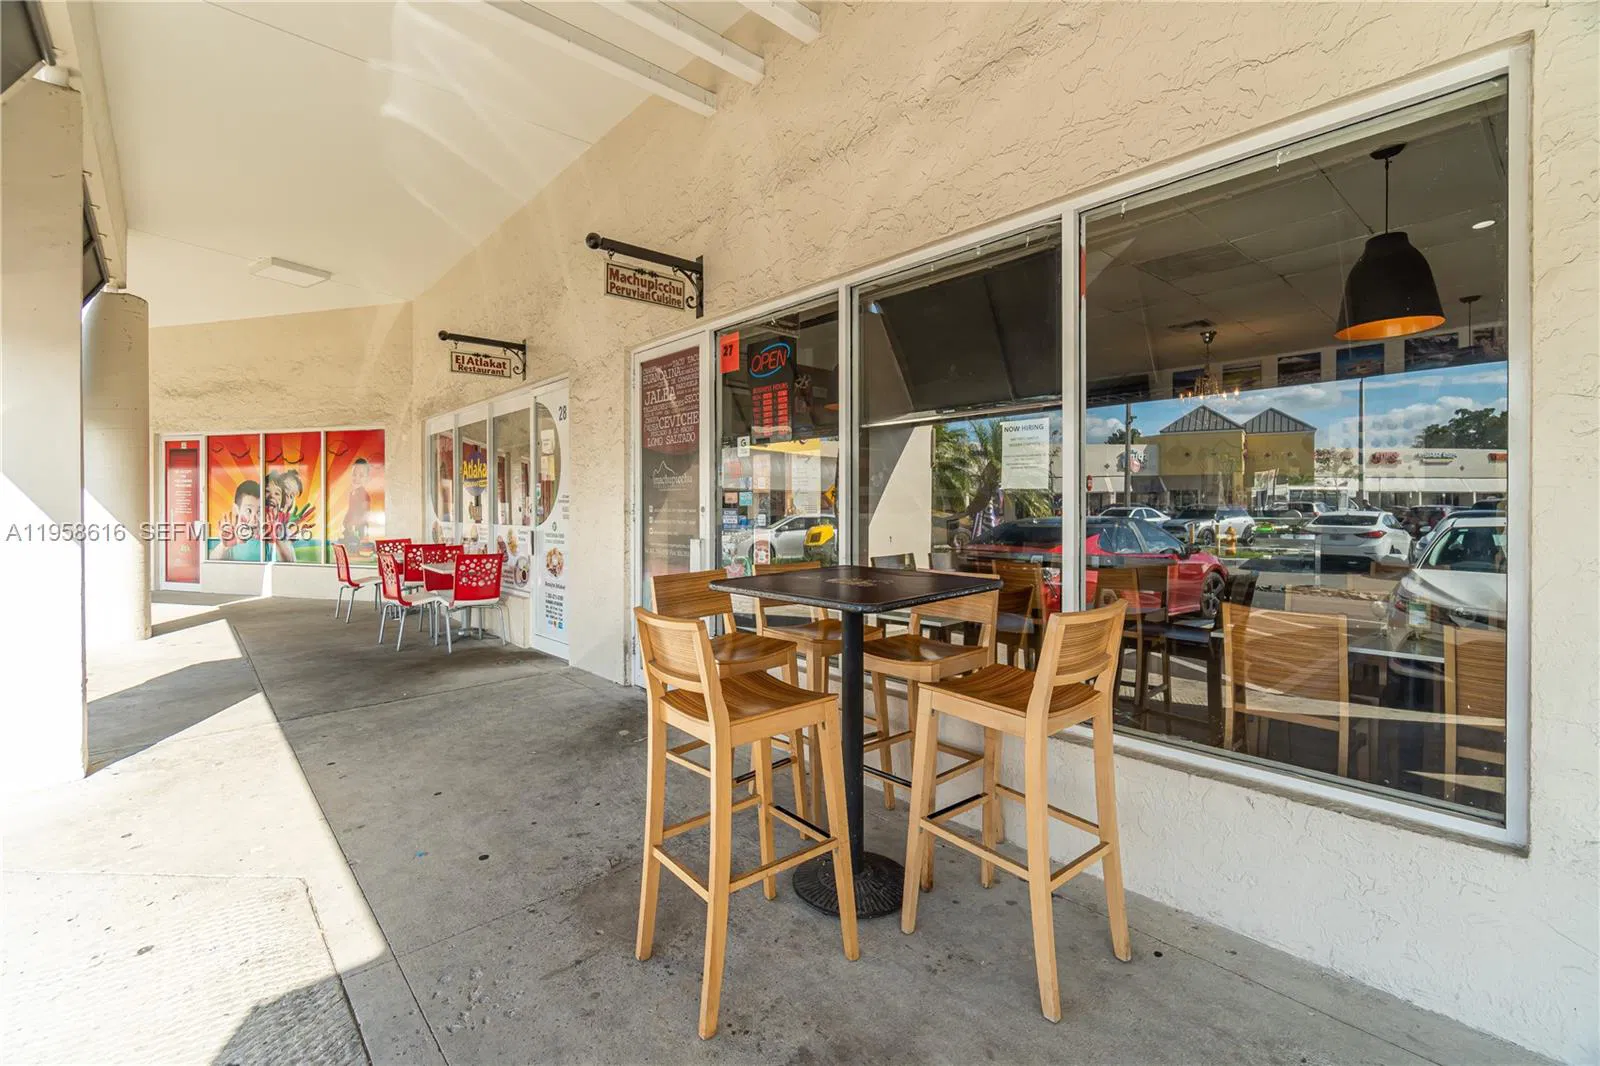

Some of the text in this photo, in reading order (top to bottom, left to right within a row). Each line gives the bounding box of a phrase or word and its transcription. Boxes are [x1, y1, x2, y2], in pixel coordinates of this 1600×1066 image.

[609, 267, 682, 296] Machupicchu
[610, 282, 682, 307] Peruvian Cuisine
[723, 344, 733, 356] 27
[455, 355, 507, 370] El Atlakat
[458, 364, 505, 376] Restaurant
[752, 349, 787, 372] OPEN
[558, 405, 568, 421] 28
[658, 411, 699, 430] CEVICHE
[463, 459, 487, 479] Atlaka
